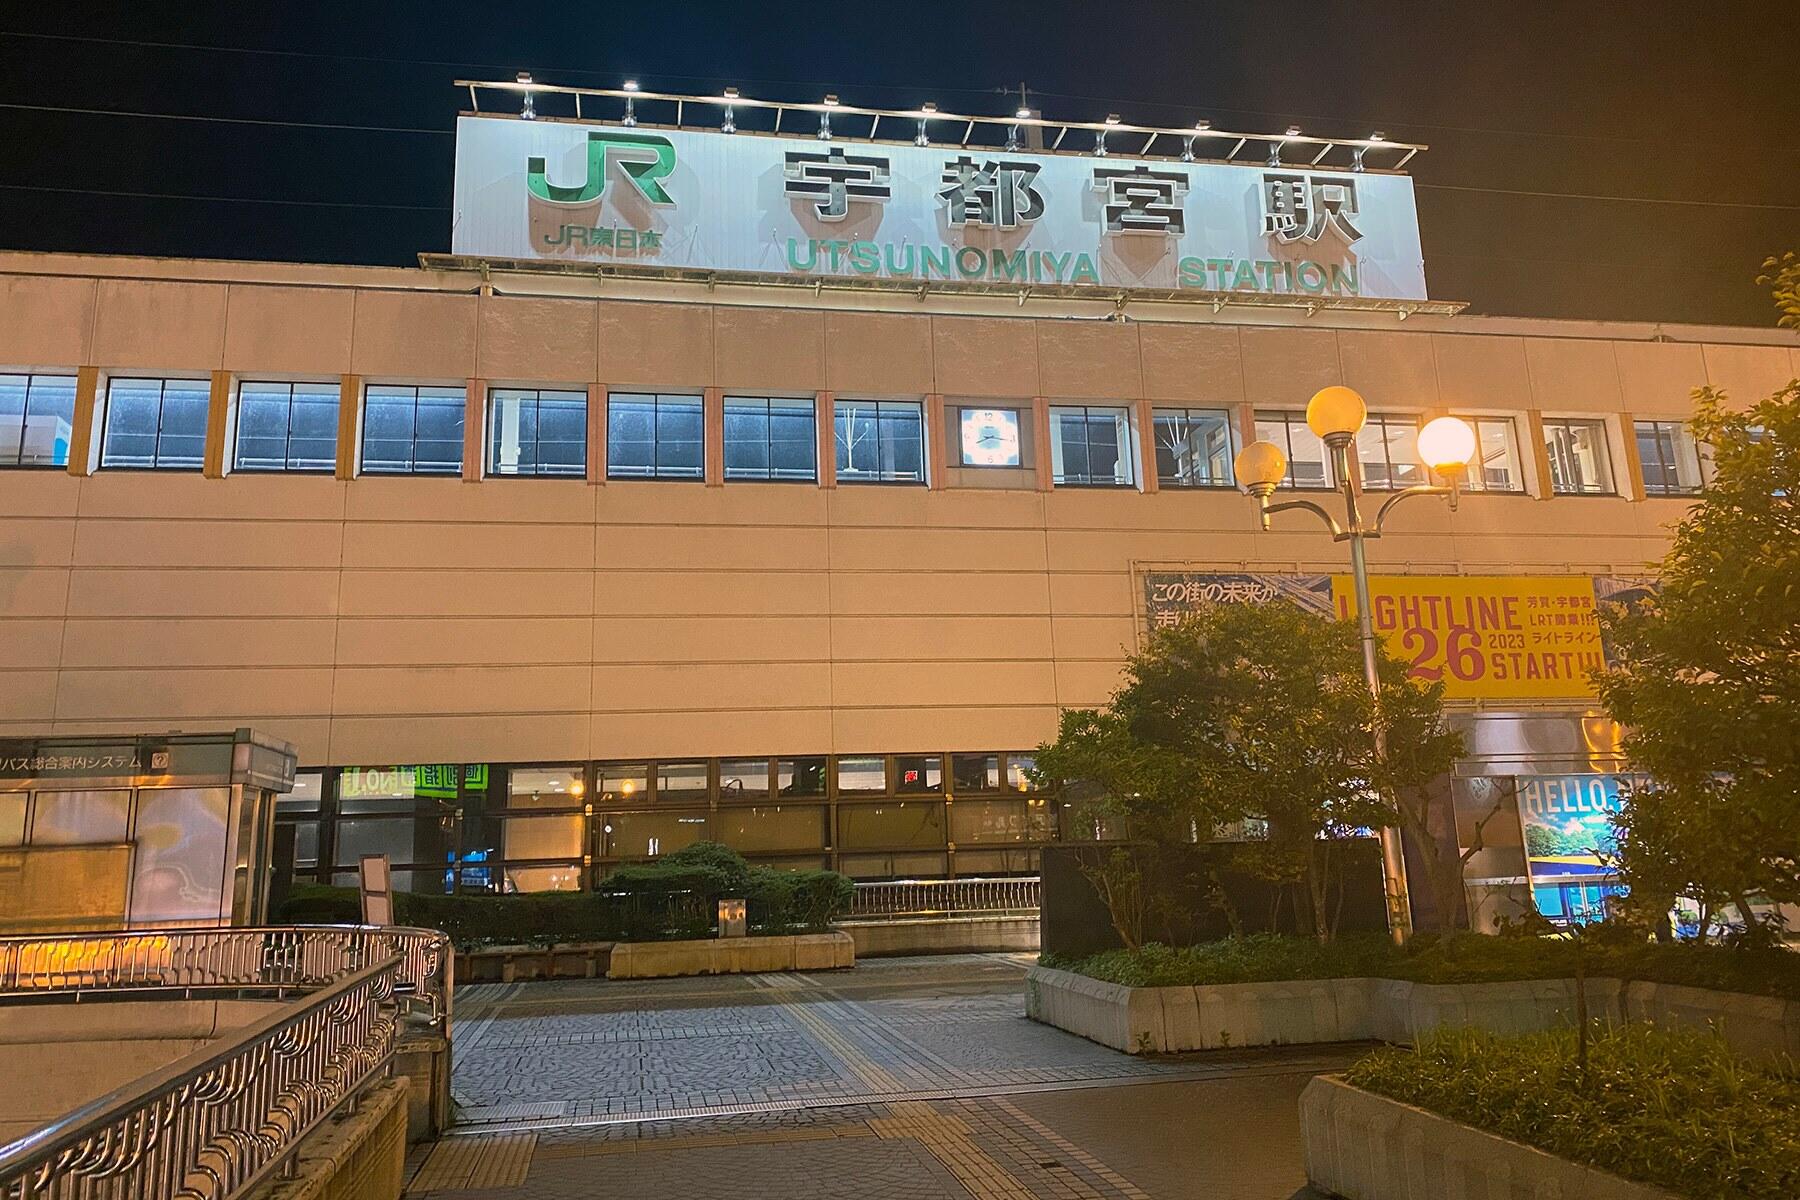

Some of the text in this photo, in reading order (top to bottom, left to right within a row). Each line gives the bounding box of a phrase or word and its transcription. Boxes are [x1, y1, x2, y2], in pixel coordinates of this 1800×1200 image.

[528, 130, 677, 210] JR
[783, 147, 1364, 245] 宇都宮駅
[544, 224, 663, 249] JR東日本
[786, 238, 1360, 294] UTSUNOMIYA STATION
[1340, 595, 1522, 632] GHTLINE
[1488, 634, 1525, 649] 2023
[0, 756, 142, 770] バス総合案内システム
